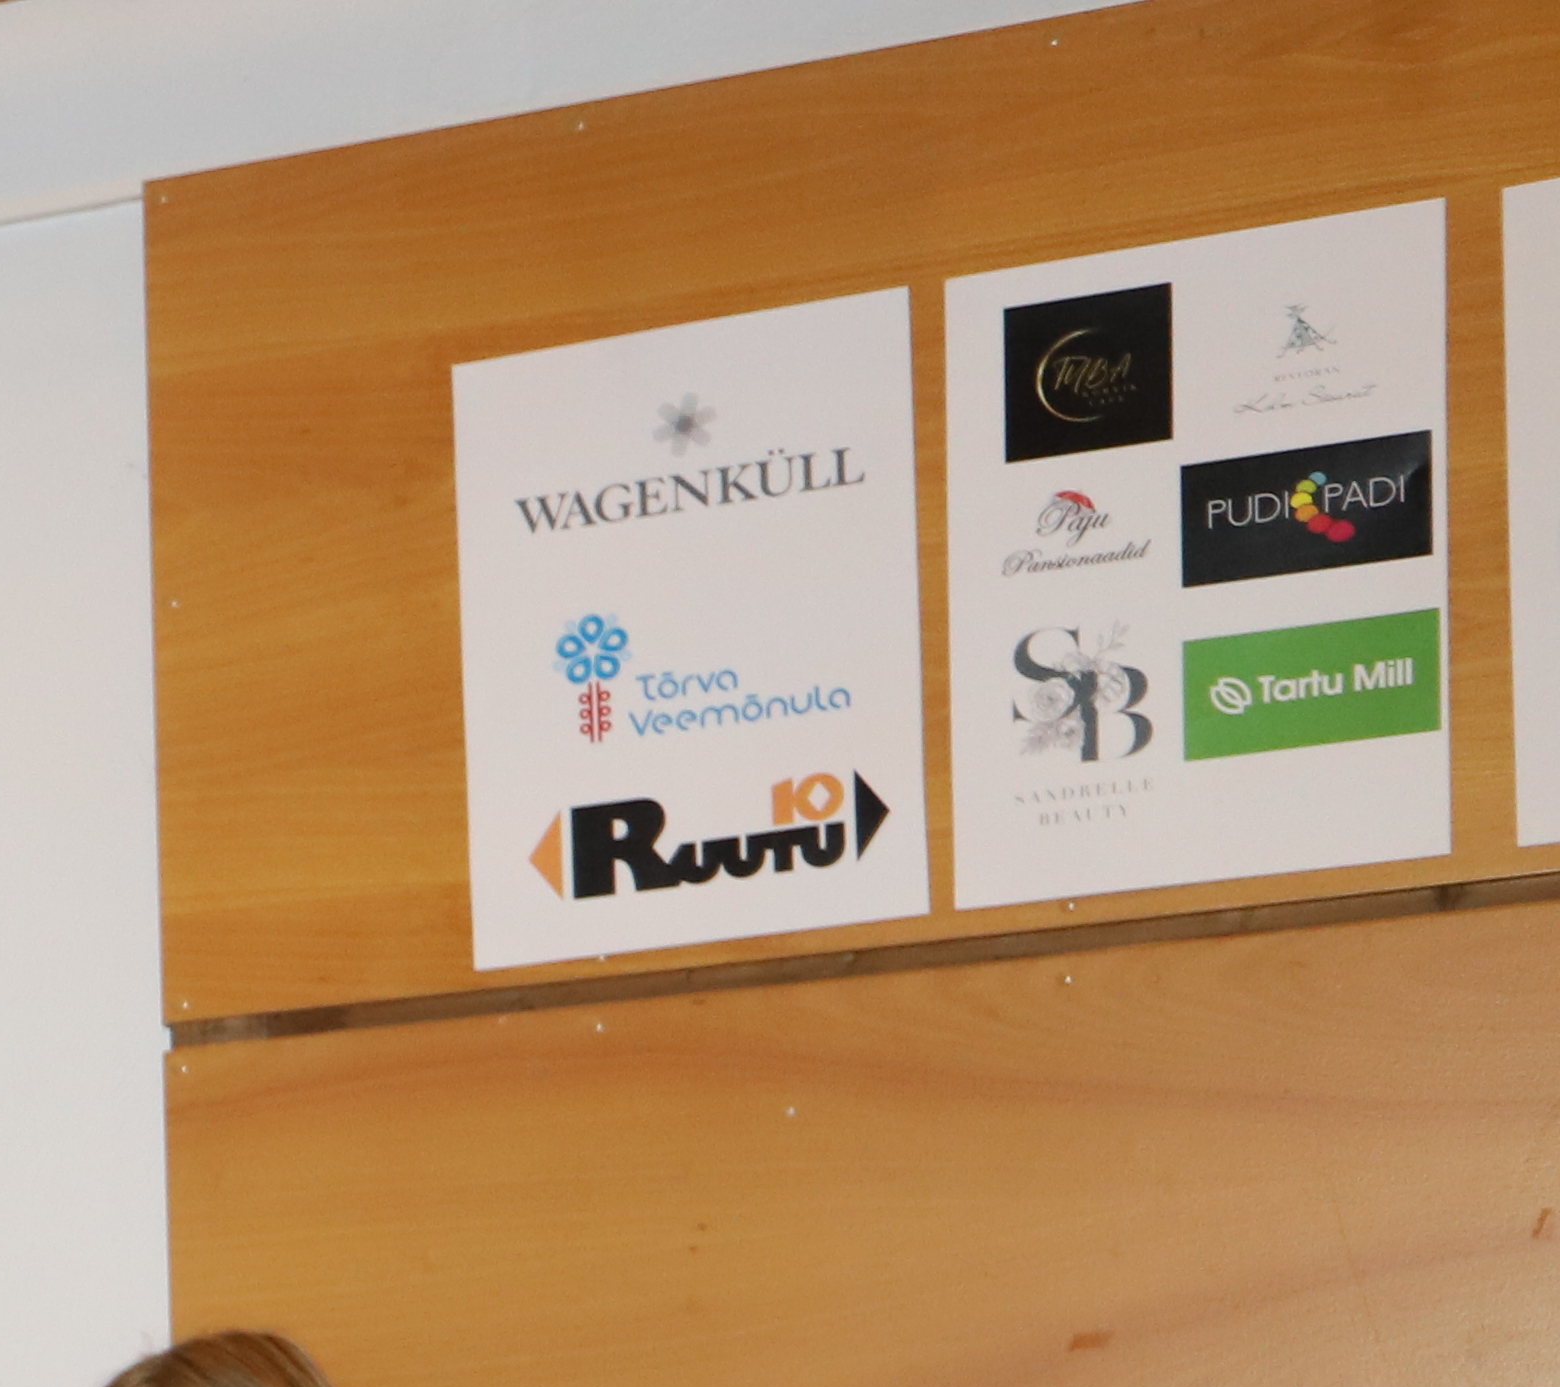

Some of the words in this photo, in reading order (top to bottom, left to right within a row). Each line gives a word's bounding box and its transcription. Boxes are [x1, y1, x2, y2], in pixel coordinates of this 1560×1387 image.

[514, 447, 866, 534] WAGENKÜLL
[1207, 491, 1290, 530] PUDI
[1324, 474, 1407, 514] PADI
[1036, 499, 1110, 547] Paju
[1001, 539, 1152, 577] Pansionaadid
[636, 669, 739, 701] Tõrva
[1258, 669, 1343, 704] Tartu
[1353, 657, 1415, 692] Mill
[629, 686, 852, 736] Veemõnula
[772, 772, 845, 825] 10
[1038, 804, 1130, 826] BEAUTY
